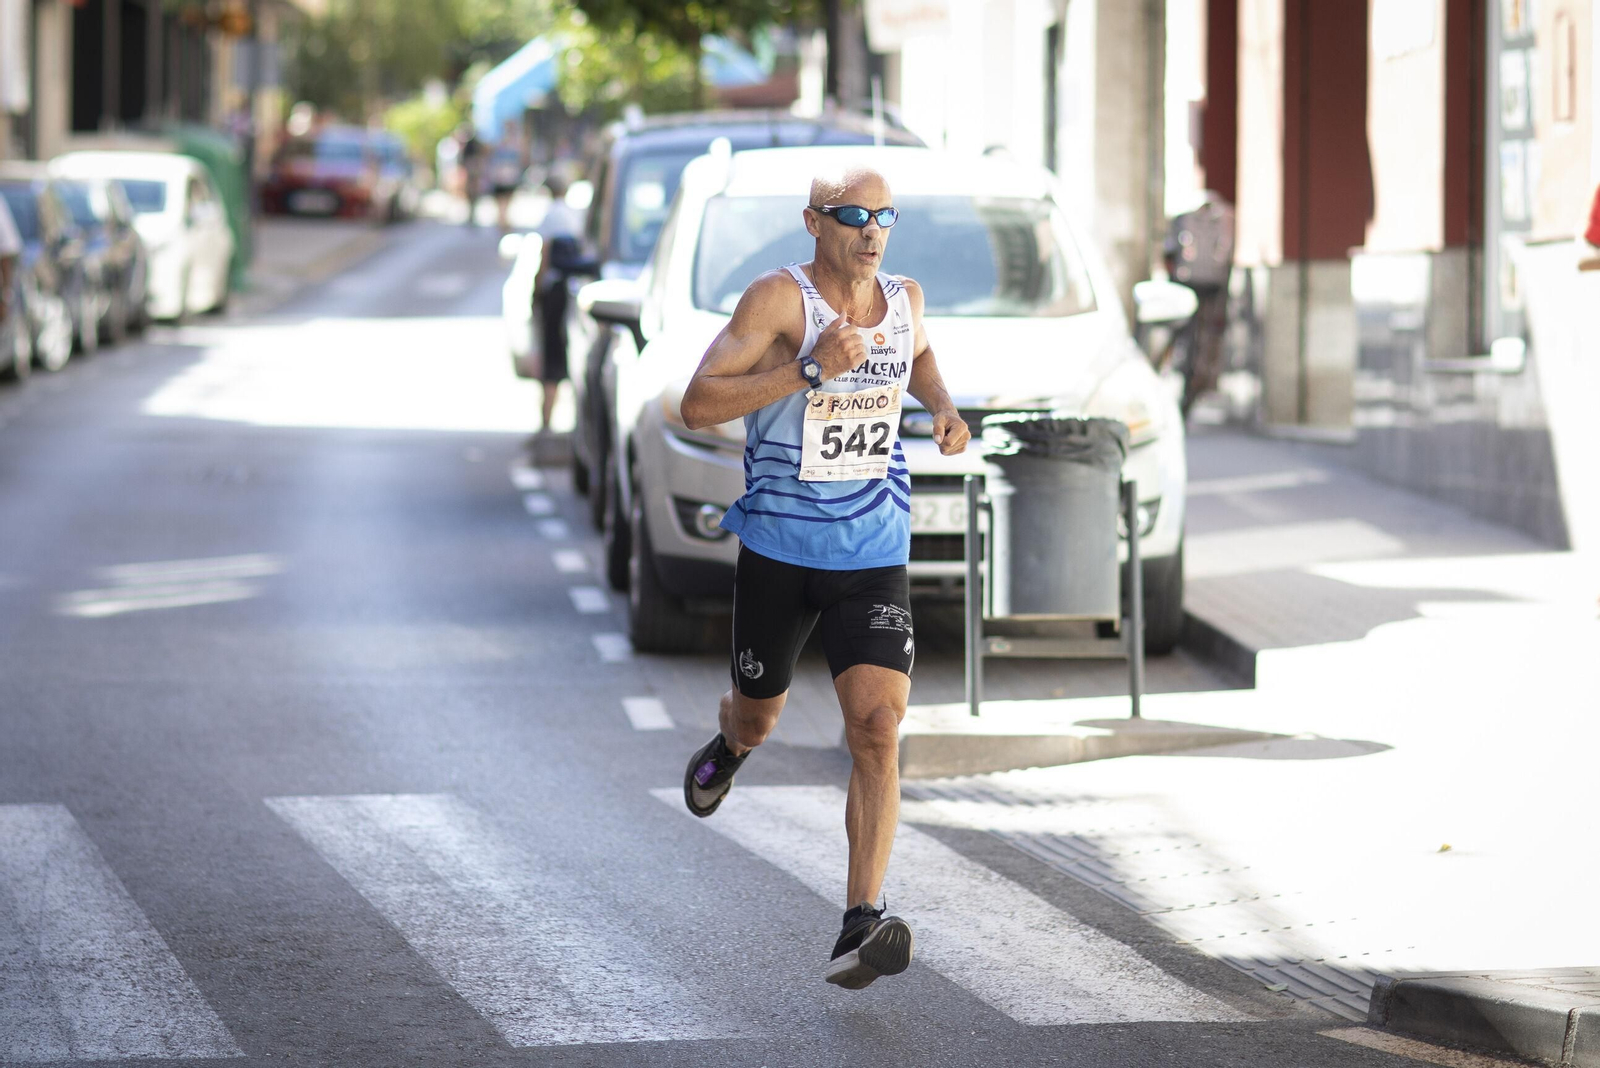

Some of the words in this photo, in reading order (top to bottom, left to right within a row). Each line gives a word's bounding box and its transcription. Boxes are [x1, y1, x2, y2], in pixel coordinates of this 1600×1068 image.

[848, 359, 907, 378] ACENA
[861, 378, 893, 386] ATLETIS
[831, 395, 889, 412] FONDO
[820, 421, 890, 460] 542
